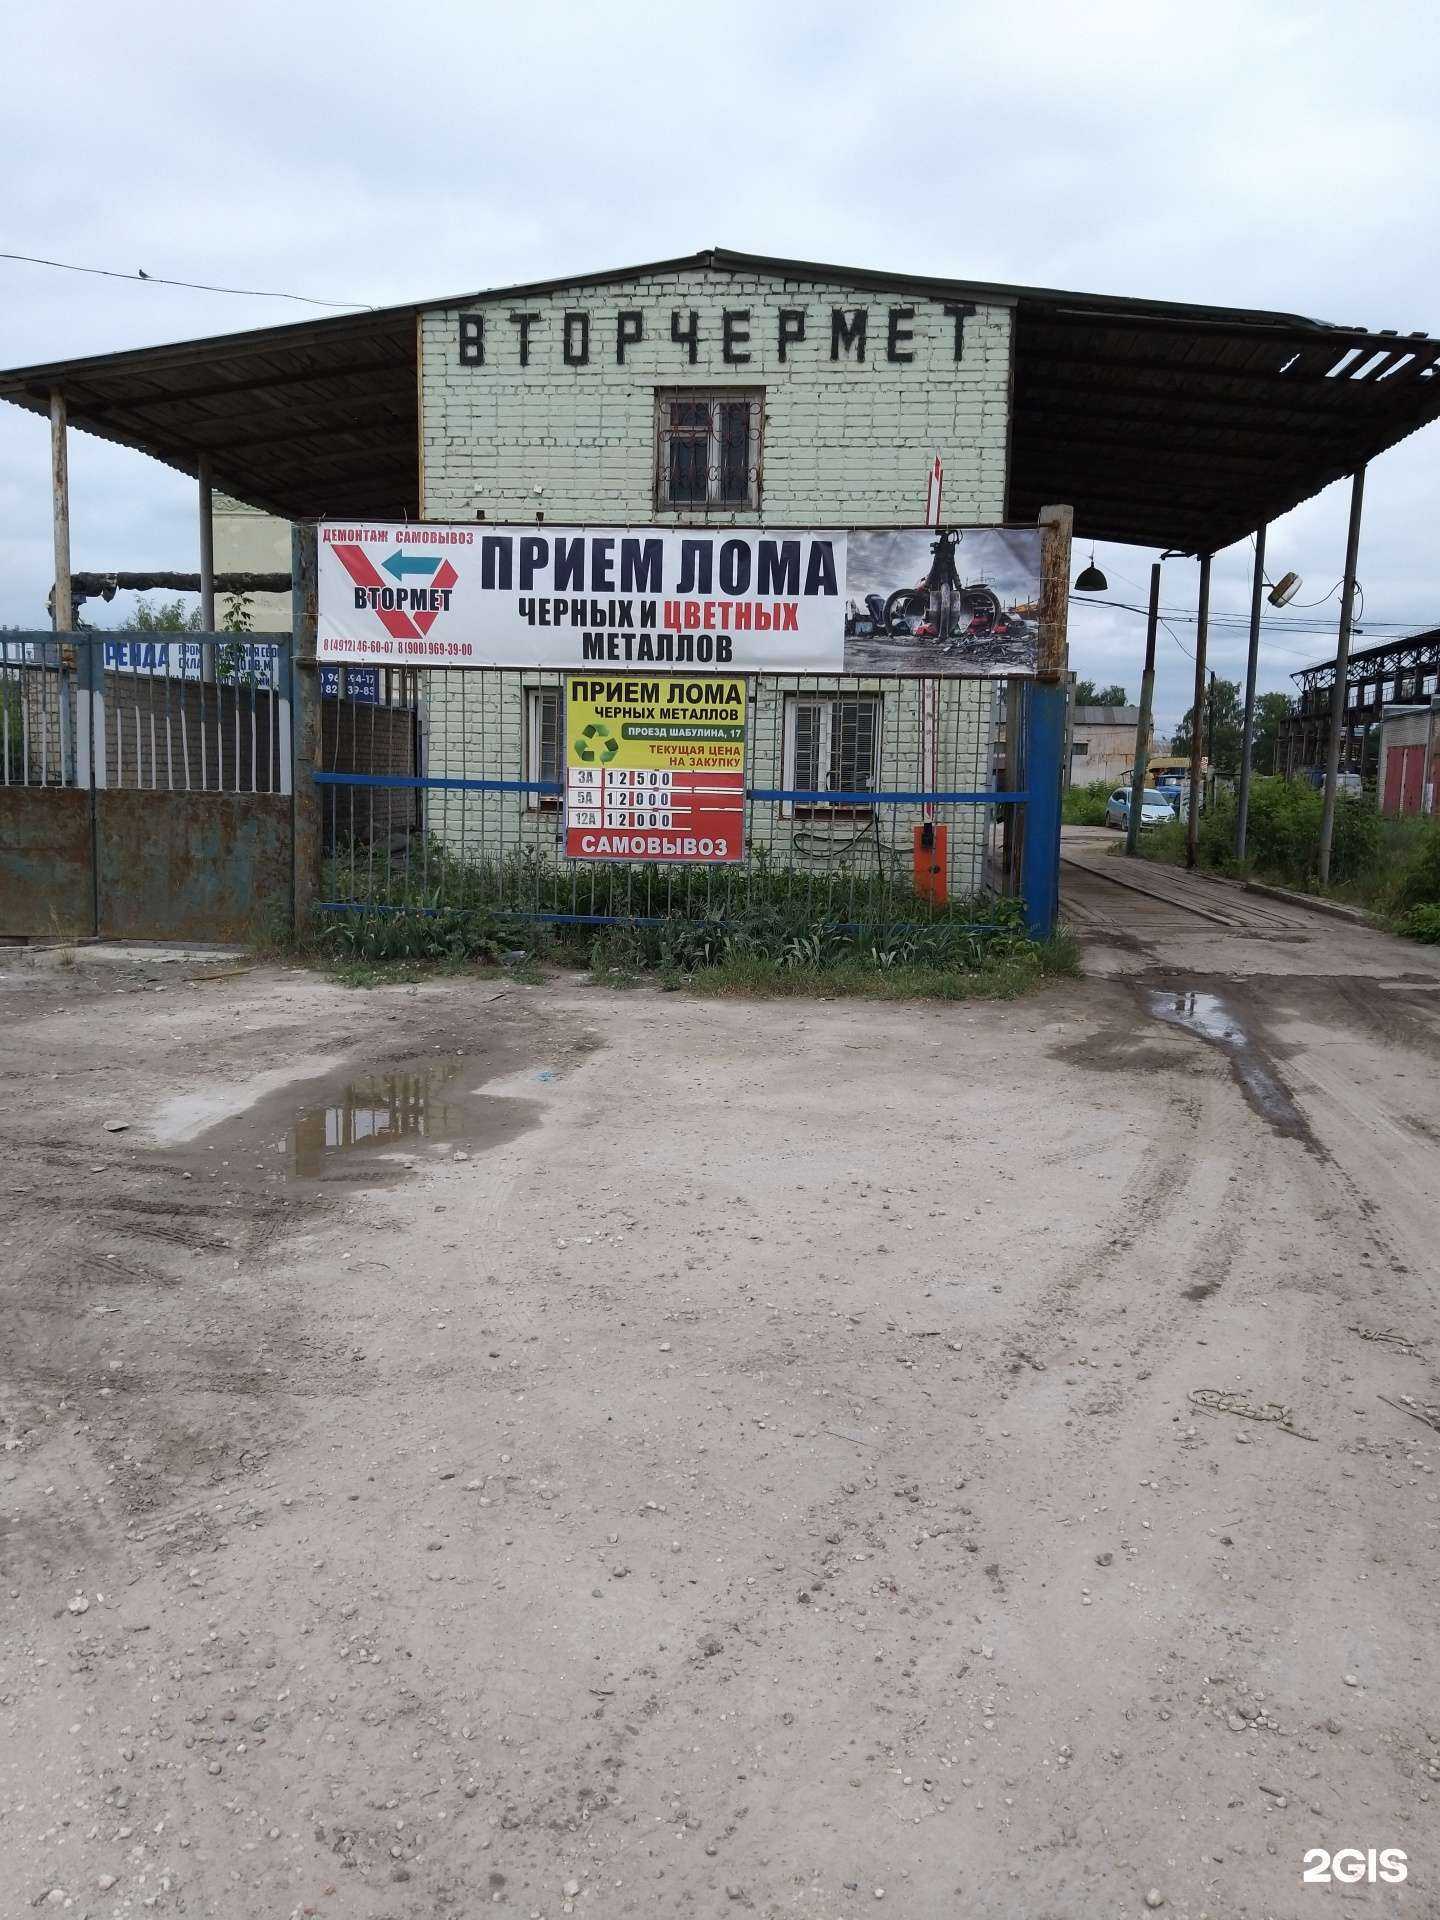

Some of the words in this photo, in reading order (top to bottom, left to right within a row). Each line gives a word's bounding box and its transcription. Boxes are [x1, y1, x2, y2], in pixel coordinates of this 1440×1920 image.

[459, 304, 975, 366] ВТОРЧЕРМЕТ
[322, 528, 388, 543] ДЕМОНТАЖ
[395, 530, 474, 544] САМОВЫВОЗ
[481, 535, 664, 594] ПРИЕМ
[676, 539, 838, 596] ЛОМА
[354, 586, 453, 612] ВТОРМЕТ
[519, 598, 635, 628] ЧЕРНЫХ
[640, 600, 657, 629] И
[663, 600, 799, 633] ЦВЕТНЫХ
[582, 632, 734, 663] МЕТАЛЛОВ
[572, 680, 659, 704] ПРИЕМ
[667, 683, 742, 705] ЛОМА
[595, 706, 655, 719] ЧЕРНЫХ
[659, 707, 739, 721] МЕТАЛЛОВ
[628, 727, 667, 738] ПРОЕЗД
[669, 728, 727, 739] ШАБУЛИНА,
[730, 729, 741, 738] 17
[649, 744, 705, 756] ТЕКУЩАЯ
[709, 746, 741, 757] ЦЕНА
[669, 757, 686, 767] НА
[689, 757, 741, 768] ЗАКУПКУ
[582, 836, 728, 856] САМОВЫВОЗ
